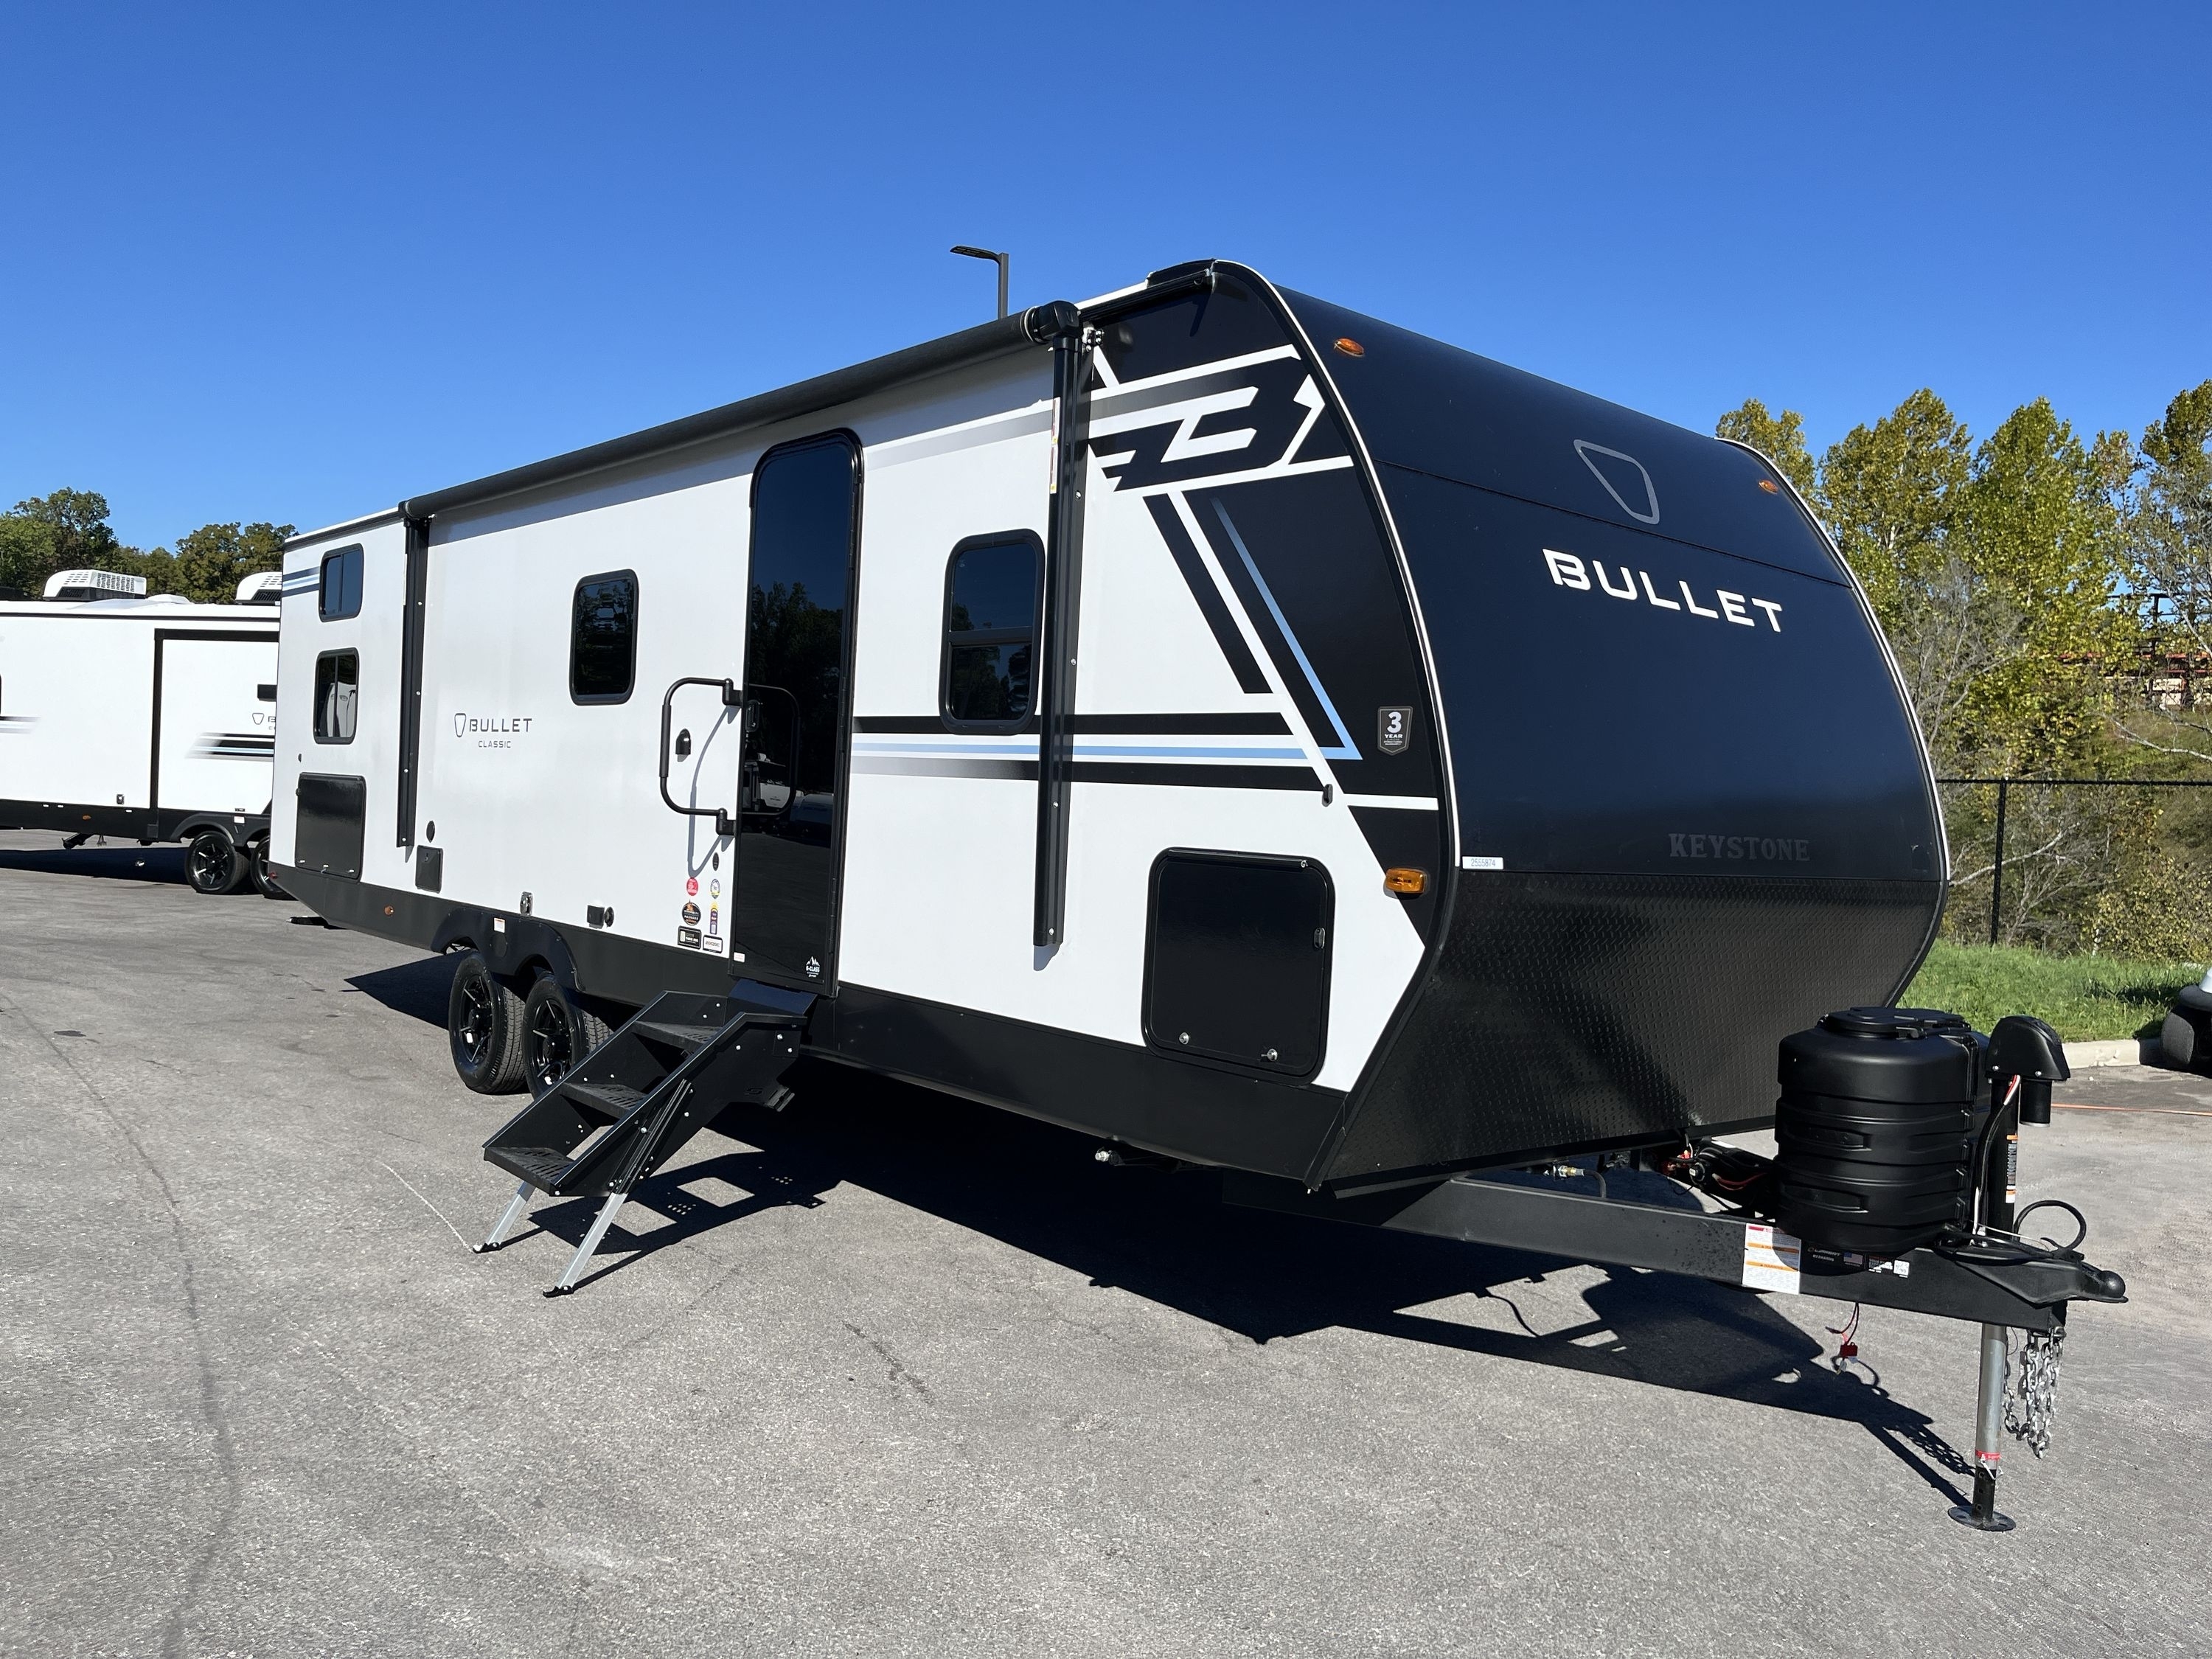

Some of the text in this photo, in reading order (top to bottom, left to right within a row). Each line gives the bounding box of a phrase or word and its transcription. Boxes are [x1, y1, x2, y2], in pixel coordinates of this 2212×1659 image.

[1543, 549, 1782, 633] BULLET
[469, 718, 532, 732] BULLET
[1387, 712, 1402, 733] 3
[478, 740, 512, 748] CLASSIC
[1668, 833, 1810, 861] KEYSTONE
